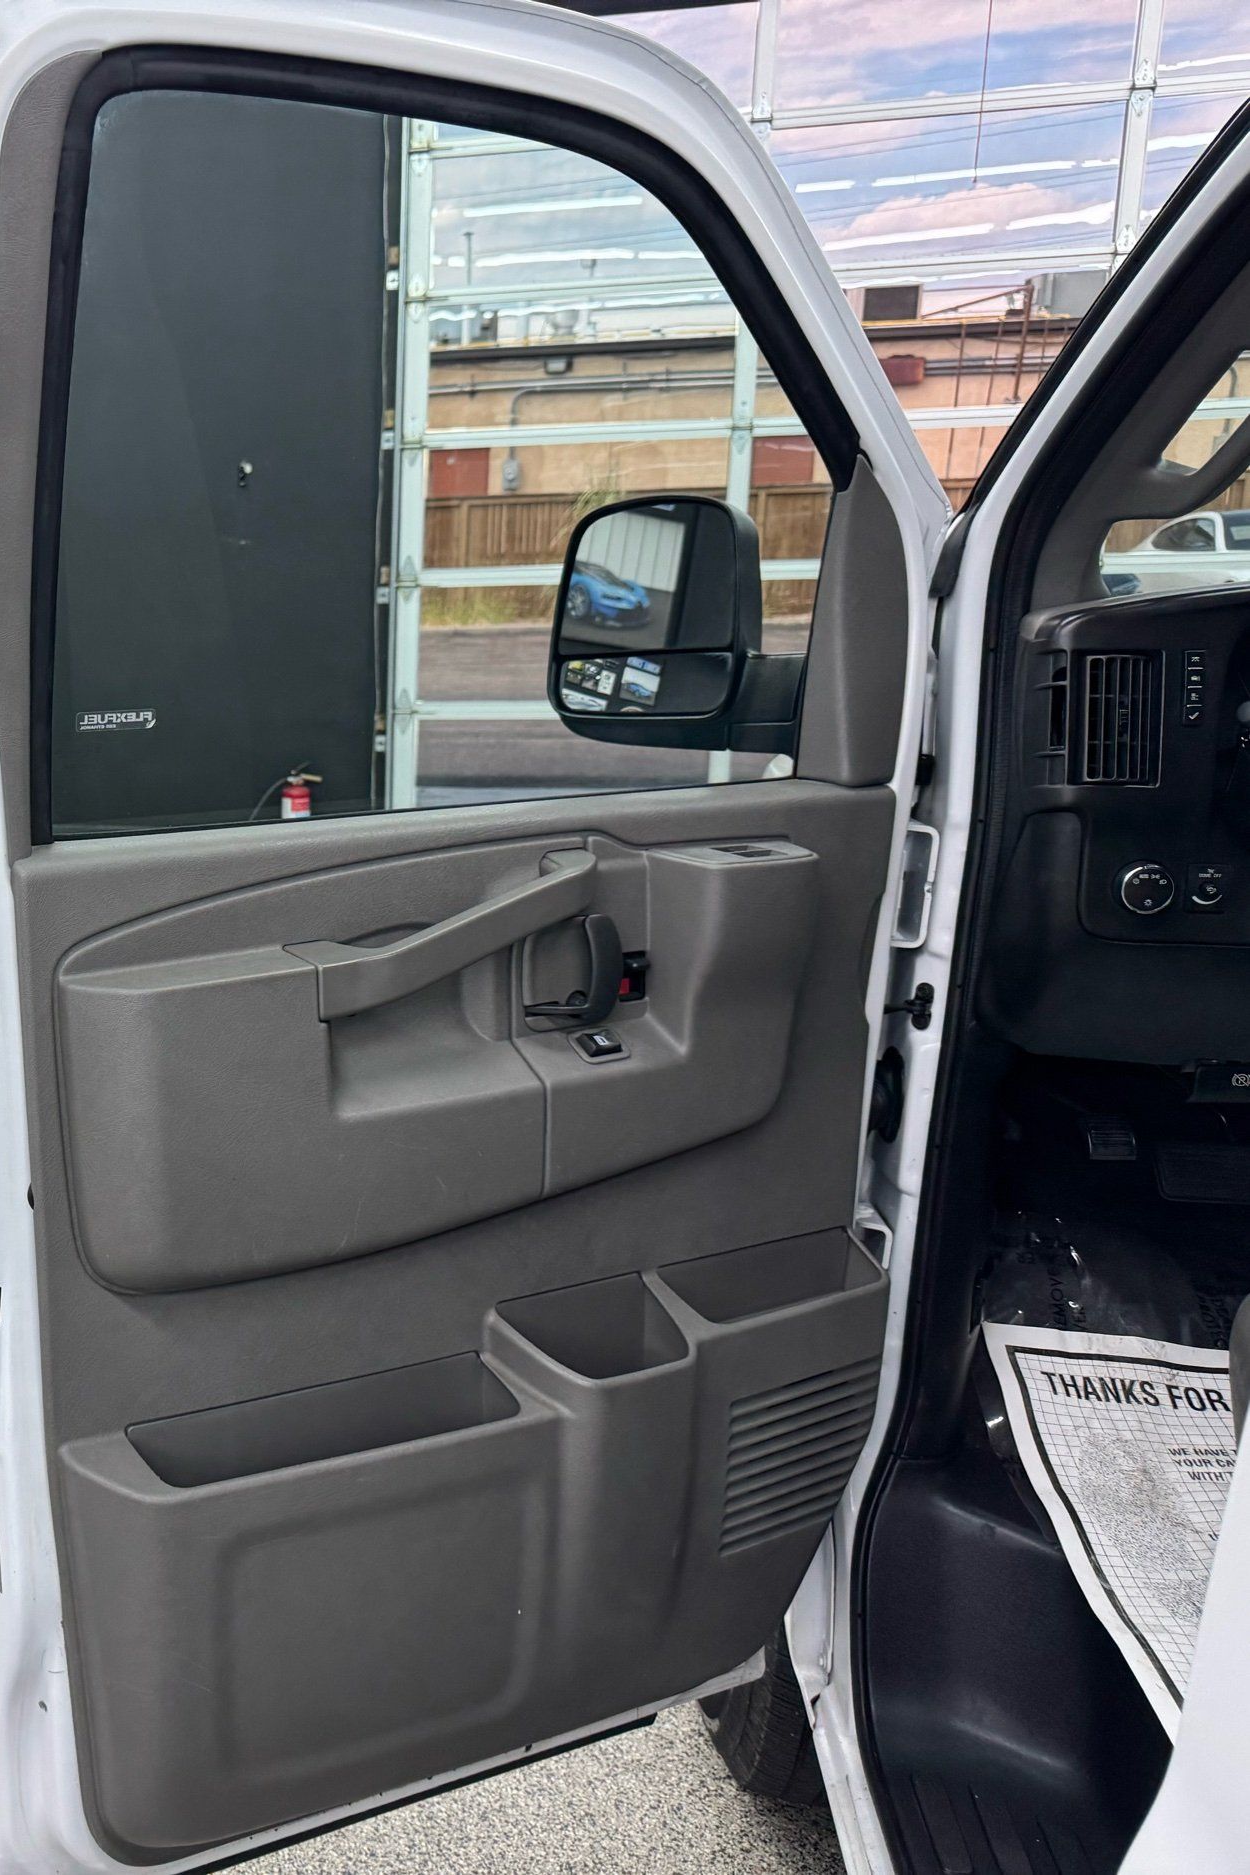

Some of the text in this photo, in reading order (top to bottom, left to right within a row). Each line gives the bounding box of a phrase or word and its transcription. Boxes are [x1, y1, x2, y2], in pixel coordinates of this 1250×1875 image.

[1040, 1371, 1232, 1413] THANKS FOR
[1168, 1448, 1191, 1456] WE
[1193, 1448, 1230, 1457] HAVE
[1172, 1459, 1237, 1468] YOUR CA
[1187, 1471, 1225, 1481] WITH
